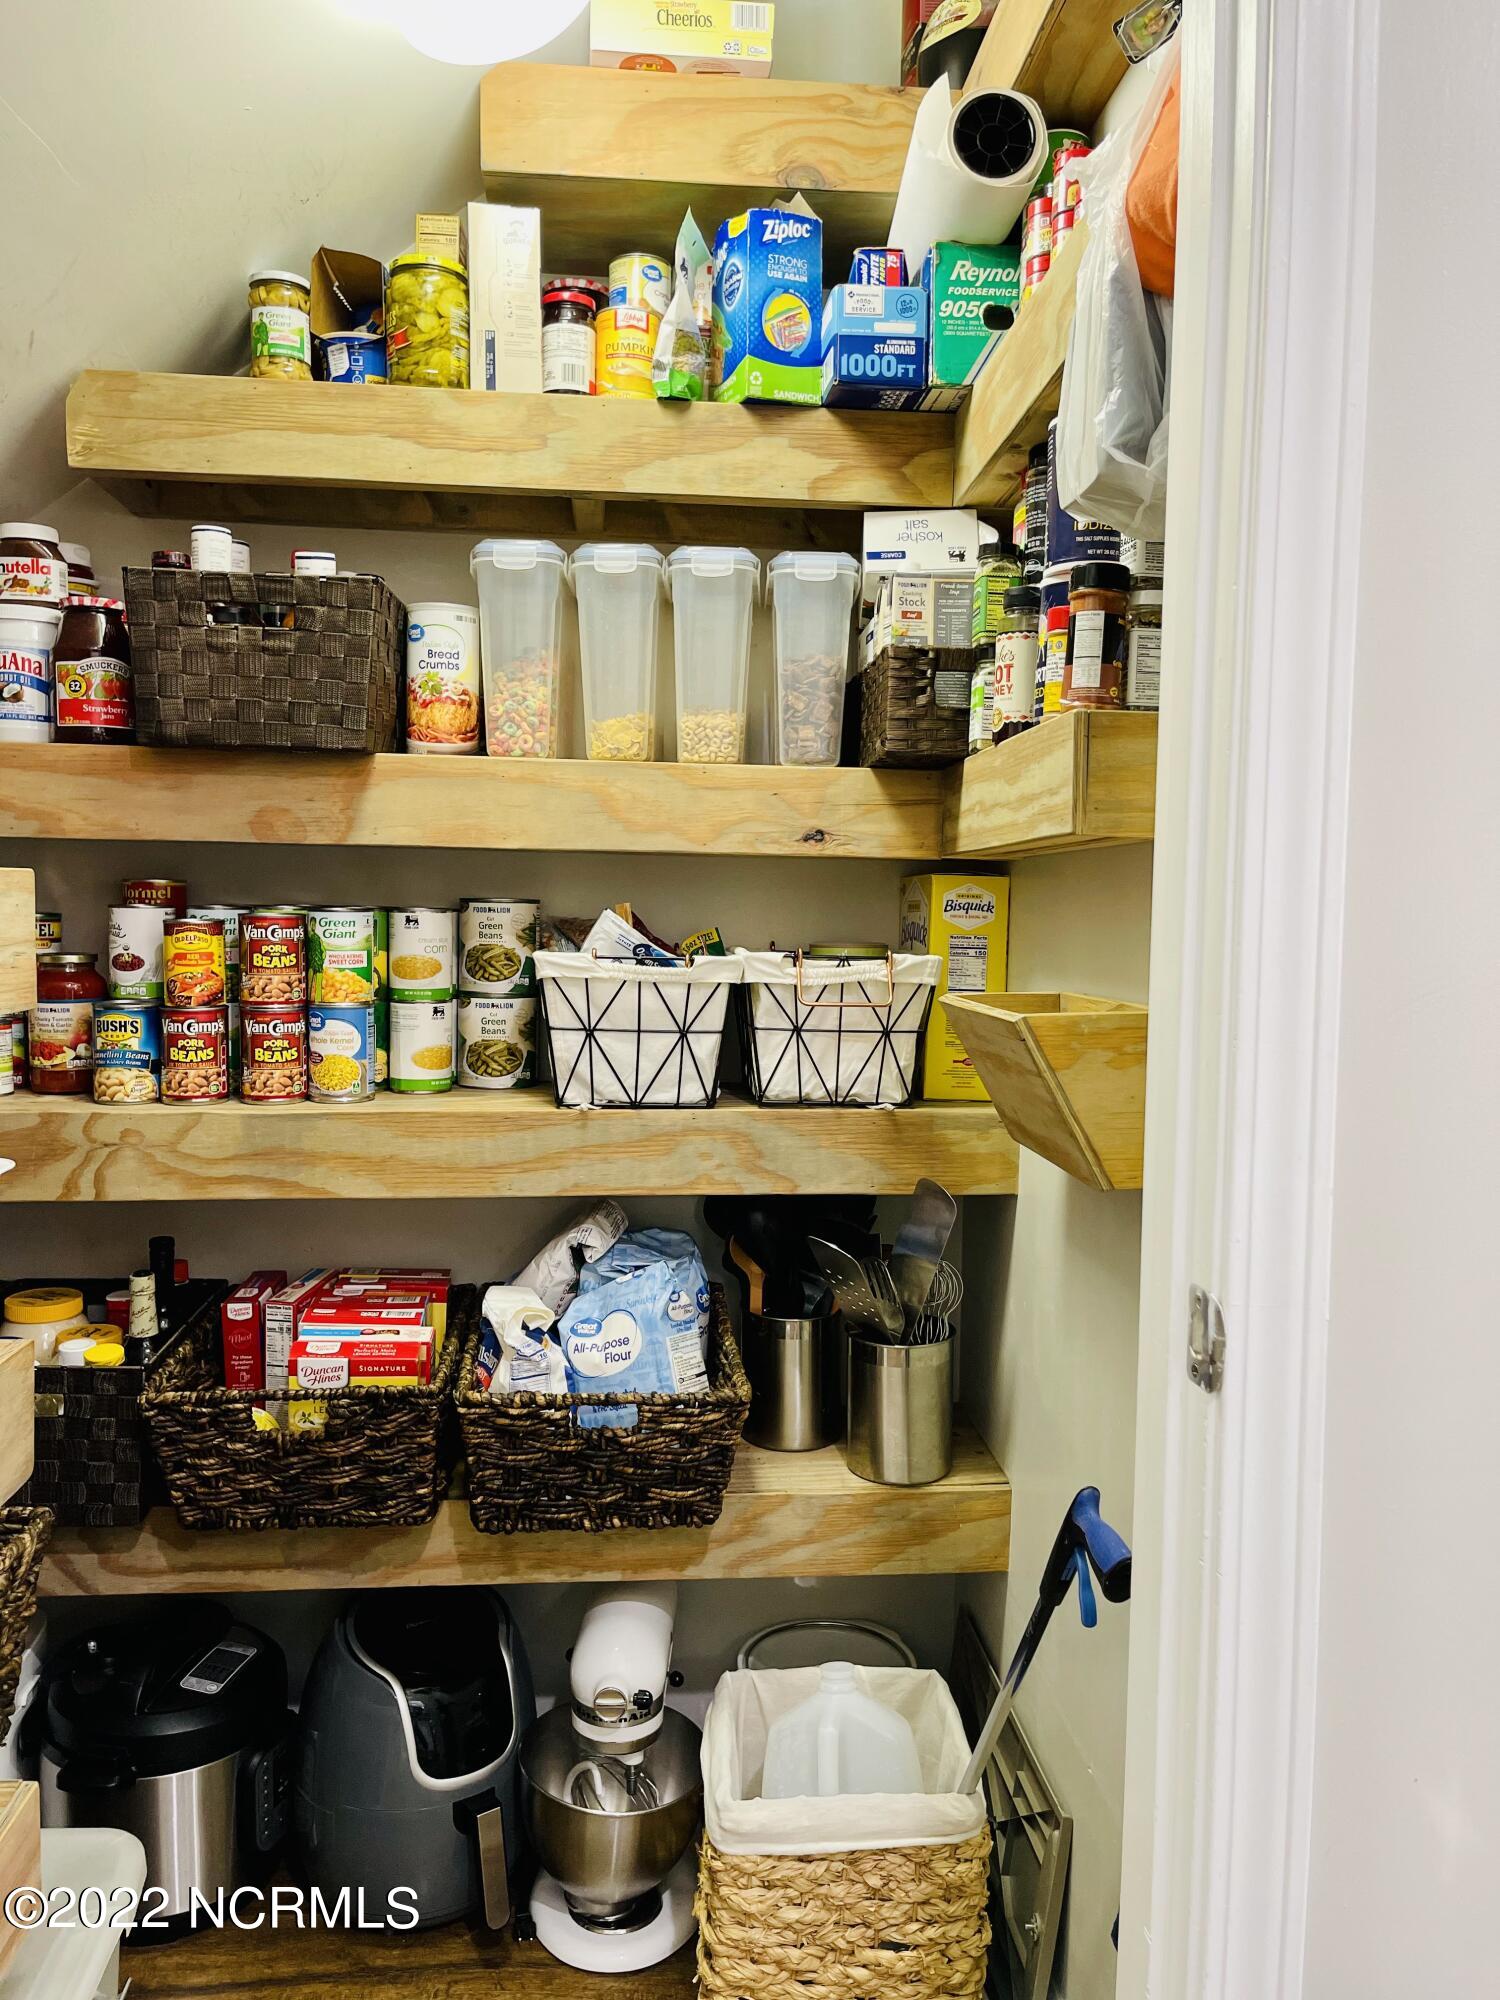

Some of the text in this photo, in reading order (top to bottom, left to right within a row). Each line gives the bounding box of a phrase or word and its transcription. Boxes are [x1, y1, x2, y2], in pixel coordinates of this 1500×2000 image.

[657, 8, 713, 28] Cheerios
[762, 219, 811, 244] Ziploc
[768, 254, 808, 269] STRONG
[768, 263, 797, 274] ENOUGH
[767, 270, 808, 283] USE AGAIN
[947, 286, 1019, 297] FOODSERVICE
[874, 344, 916, 355] STANDARD
[773, 389, 820, 403] SANDWICH
[905, 519, 928, 531] salt
[896, 531, 943, 544] kosher
[0, 558, 52, 576] nutella
[898, 597, 926, 607] Stock
[427, 649, 460, 660] Bread
[418, 660, 460, 671] Crumbs
[994, 663, 1014, 684] OT
[20, 676, 31, 686] OIL
[70, 682, 81, 691] 32
[83, 704, 128, 716] Strawberry
[944, 899, 995, 914] Bisquick
[318, 917, 356, 928] Green
[478, 921, 503, 930] Green
[35, 924, 55, 937] EL
[243, 924, 265, 941] Van
[267, 924, 304, 942] Camp's
[322, 930, 357, 939] Giant
[478, 930, 503, 939] Beans
[261, 945, 288, 954] PORK
[253, 953, 297, 968] BEANS
[96, 1019, 139, 1035] BUSH'S
[161, 1018, 225, 1036] Van Camp's
[245, 1019, 305, 1036] Van Camp's
[480, 1017, 507, 1026] Green
[481, 1026, 506, 1035] Beans
[177, 1039, 204, 1048] PORK
[263, 1039, 289, 1049] PORK
[125, 1051, 149, 1060] Beans
[170, 1047, 214, 1062] BEANS
[254, 1047, 298, 1062] BEANS
[574, 1322, 598, 1331] Great
[573, 1336, 630, 1354] All-Pupose
[604, 1350, 632, 1364] Flour
[301, 1365, 344, 1378] Duncan
[307, 1374, 341, 1386] Hines
